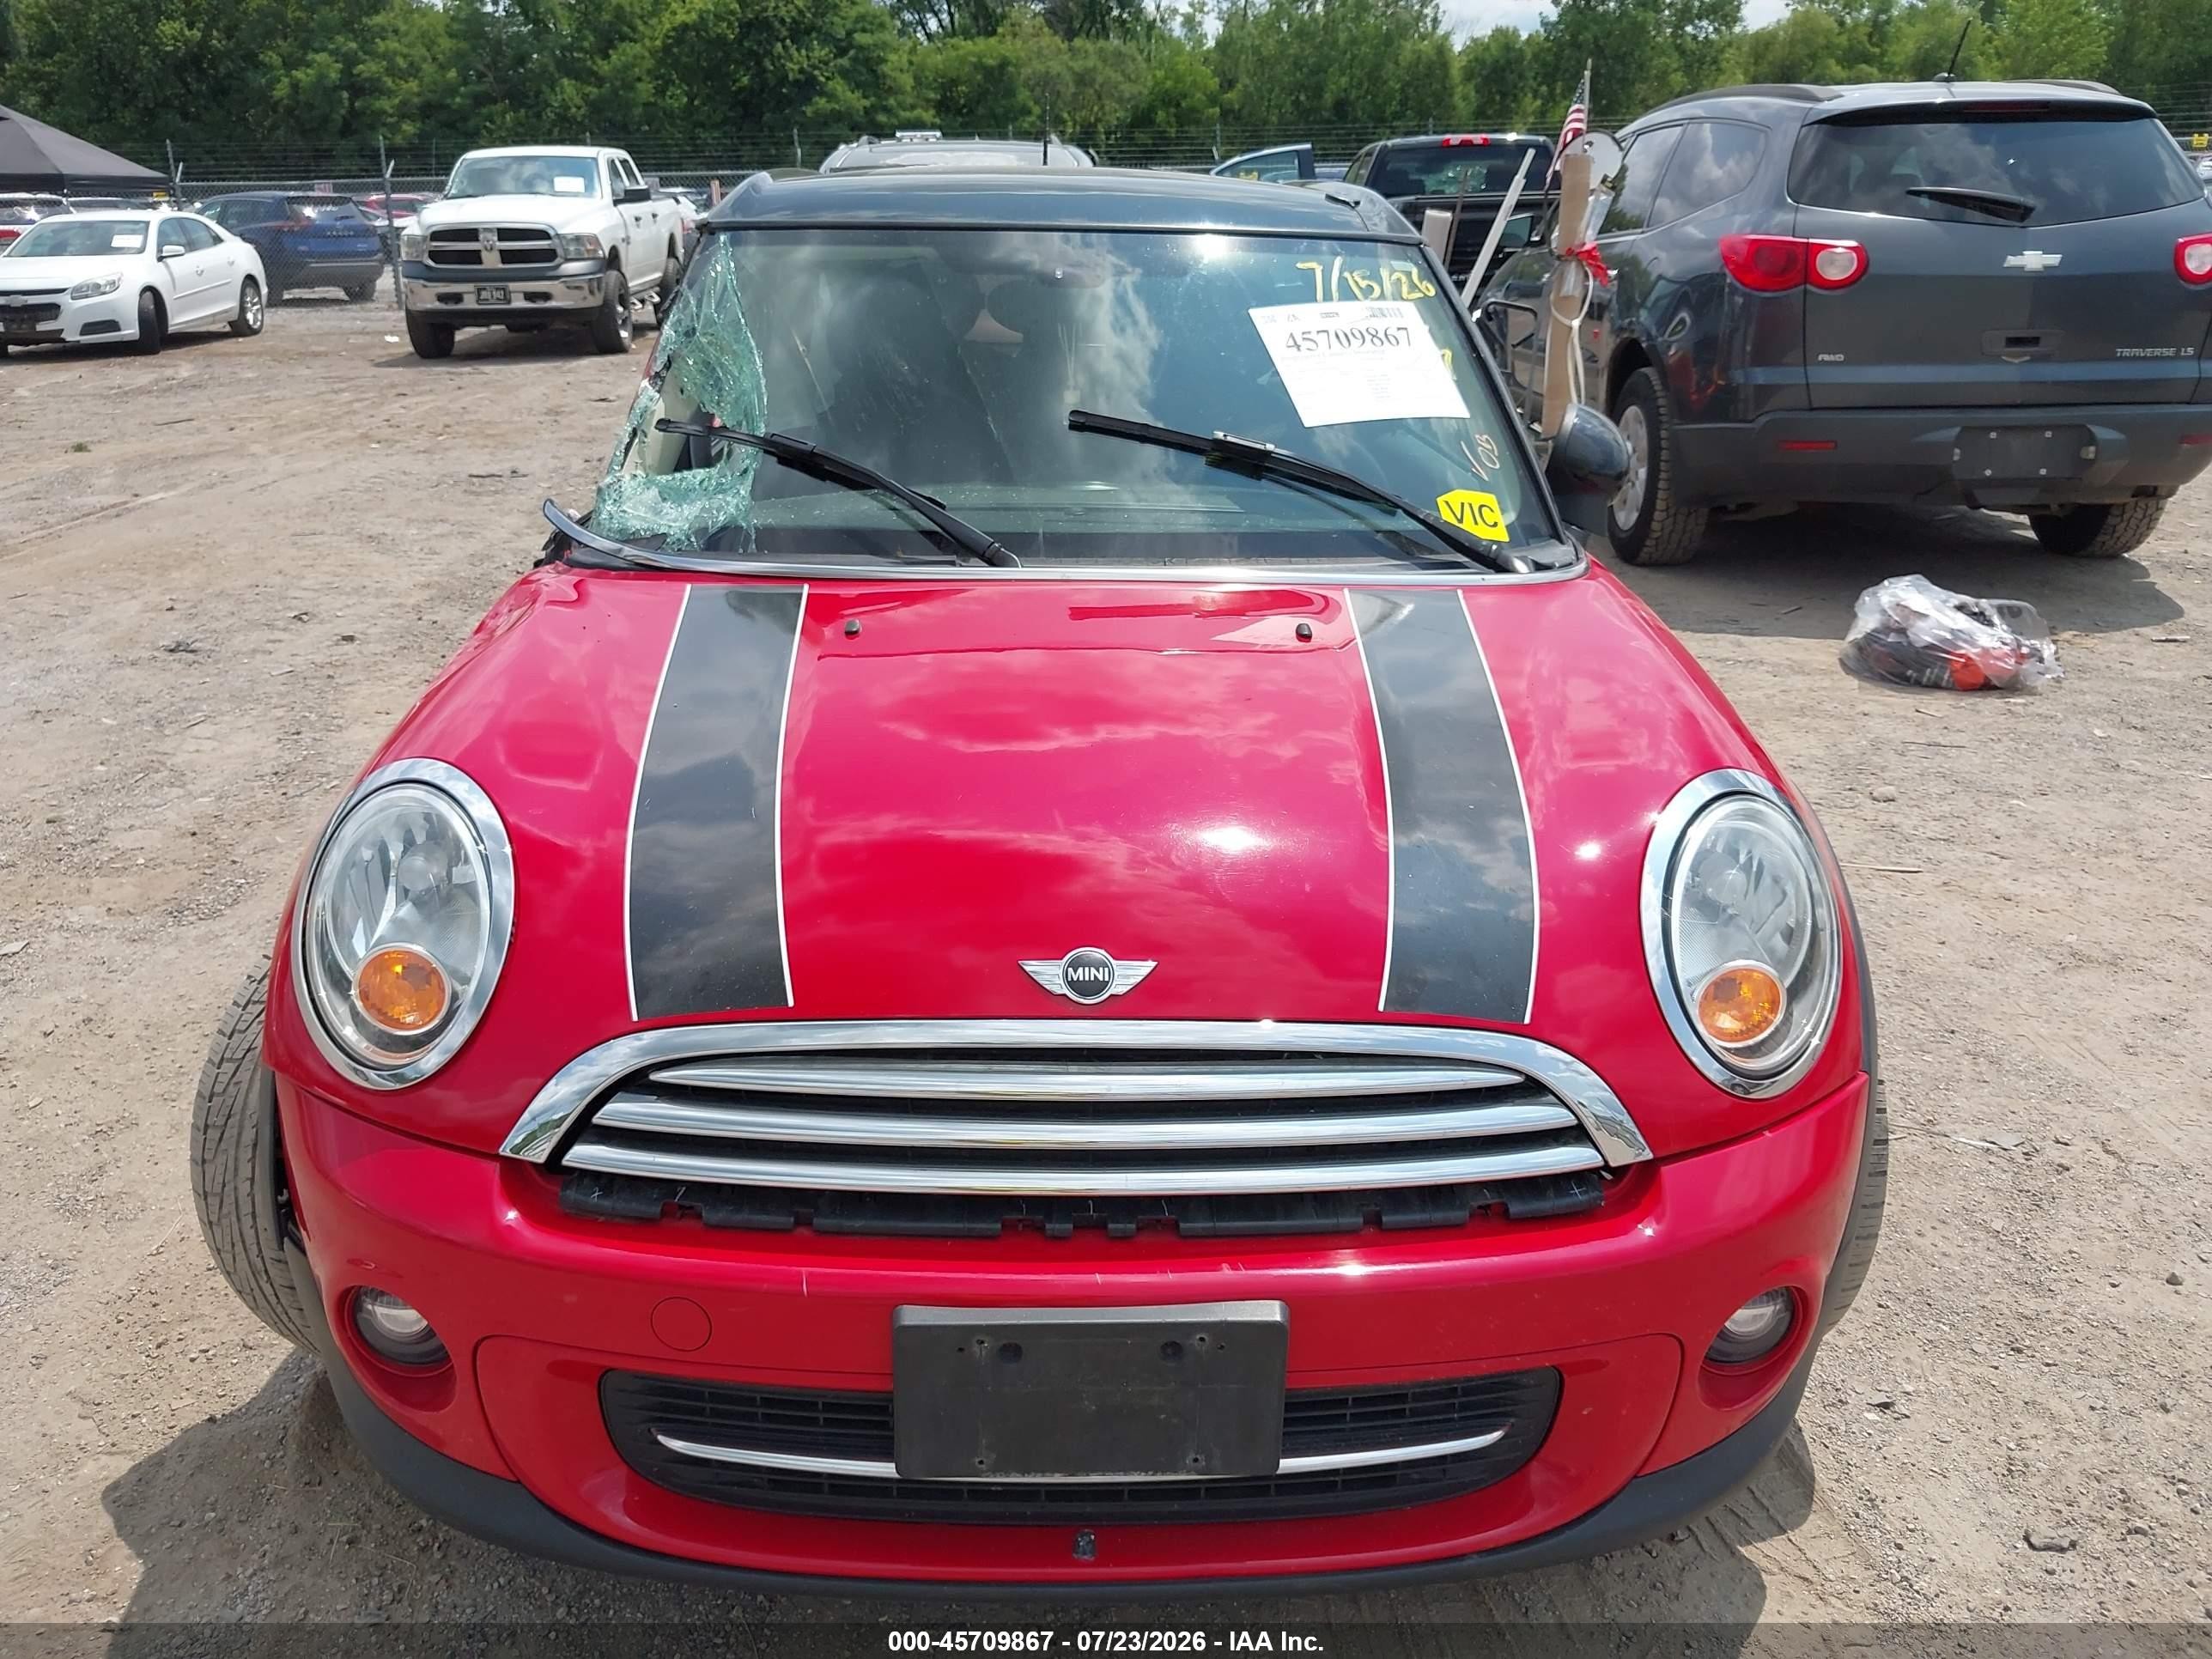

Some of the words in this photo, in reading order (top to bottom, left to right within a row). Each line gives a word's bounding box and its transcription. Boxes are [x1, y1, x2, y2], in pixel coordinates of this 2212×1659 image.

[1296, 256, 1437, 303] 7/15/26
[1285, 326, 1411, 352] 45709867
[1817, 353, 1845, 362] AWD
[2115, 347, 2177, 357] TRAVERSE
[2180, 347, 2195, 356] LS
[1443, 500, 1499, 528] VIC
[1067, 967, 1109, 981] MINI
